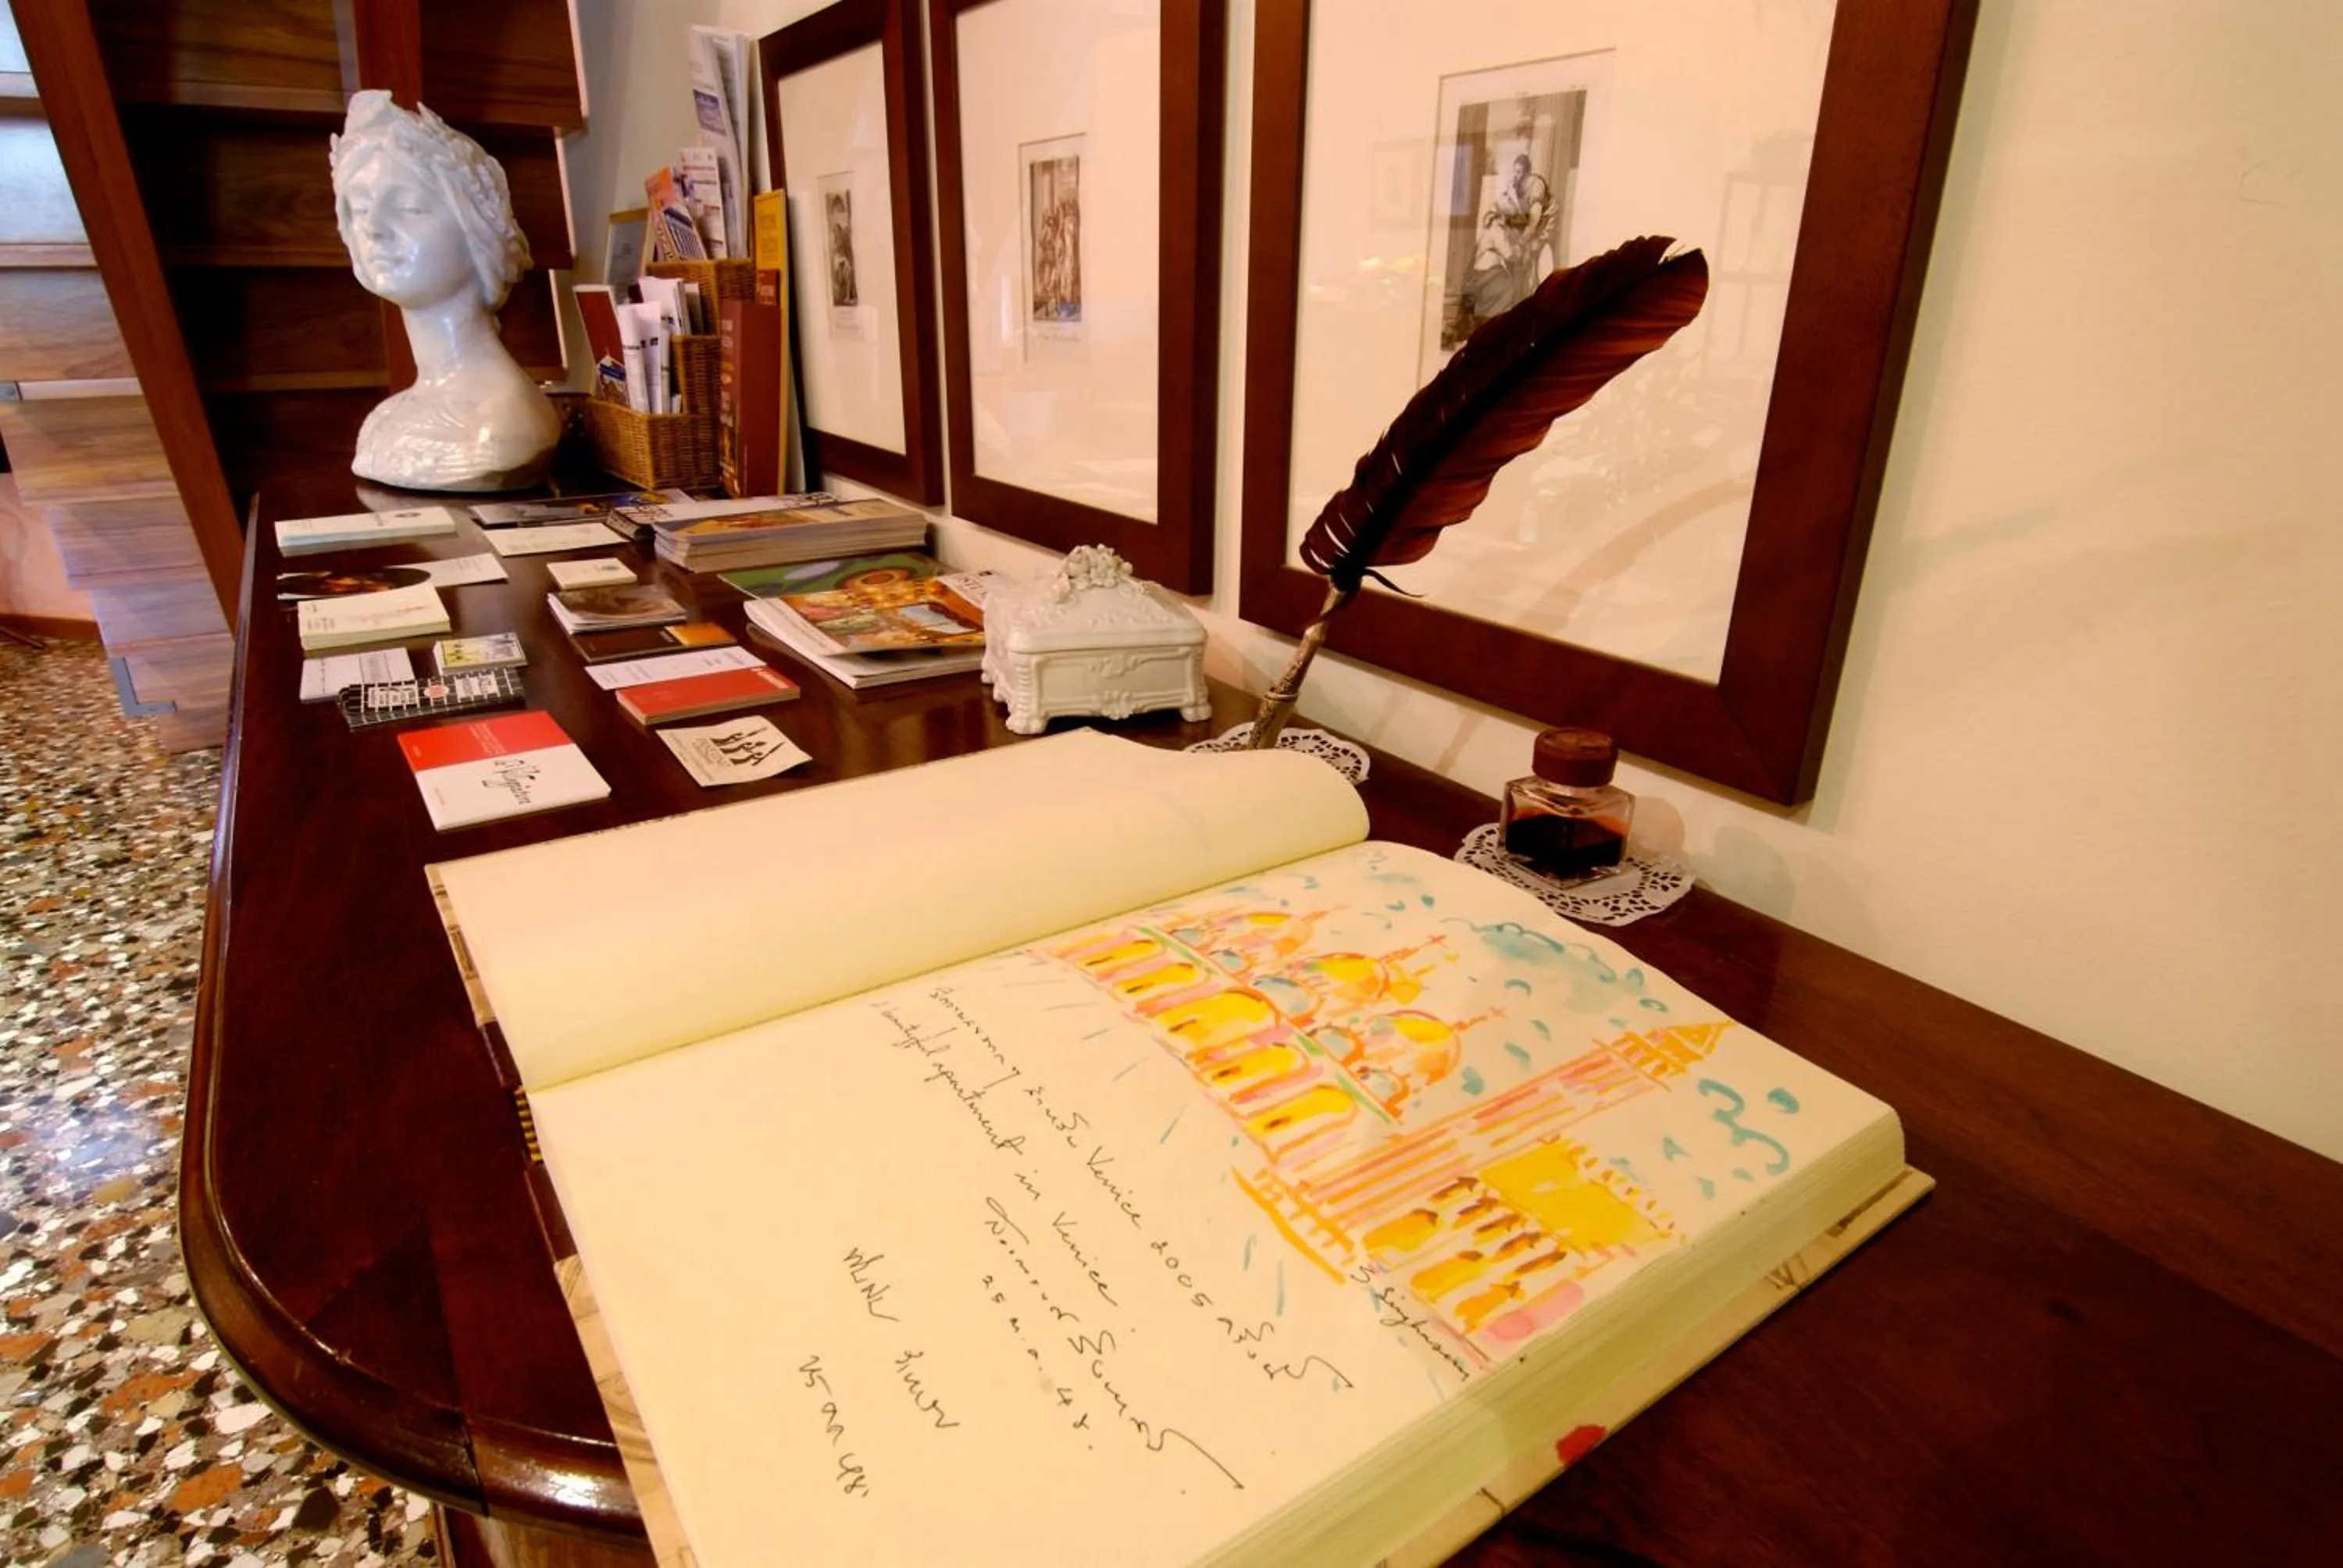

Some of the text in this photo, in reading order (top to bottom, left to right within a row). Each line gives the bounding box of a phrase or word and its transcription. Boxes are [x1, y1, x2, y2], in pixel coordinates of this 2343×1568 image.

[924, 1061, 1025, 1156] apartment
[1015, 1169, 1041, 1201] in
[1052, 1211, 1119, 1307] Venice
[1086, 1145, 1143, 1231] Venice
[1150, 1240, 1213, 1309] 2005
